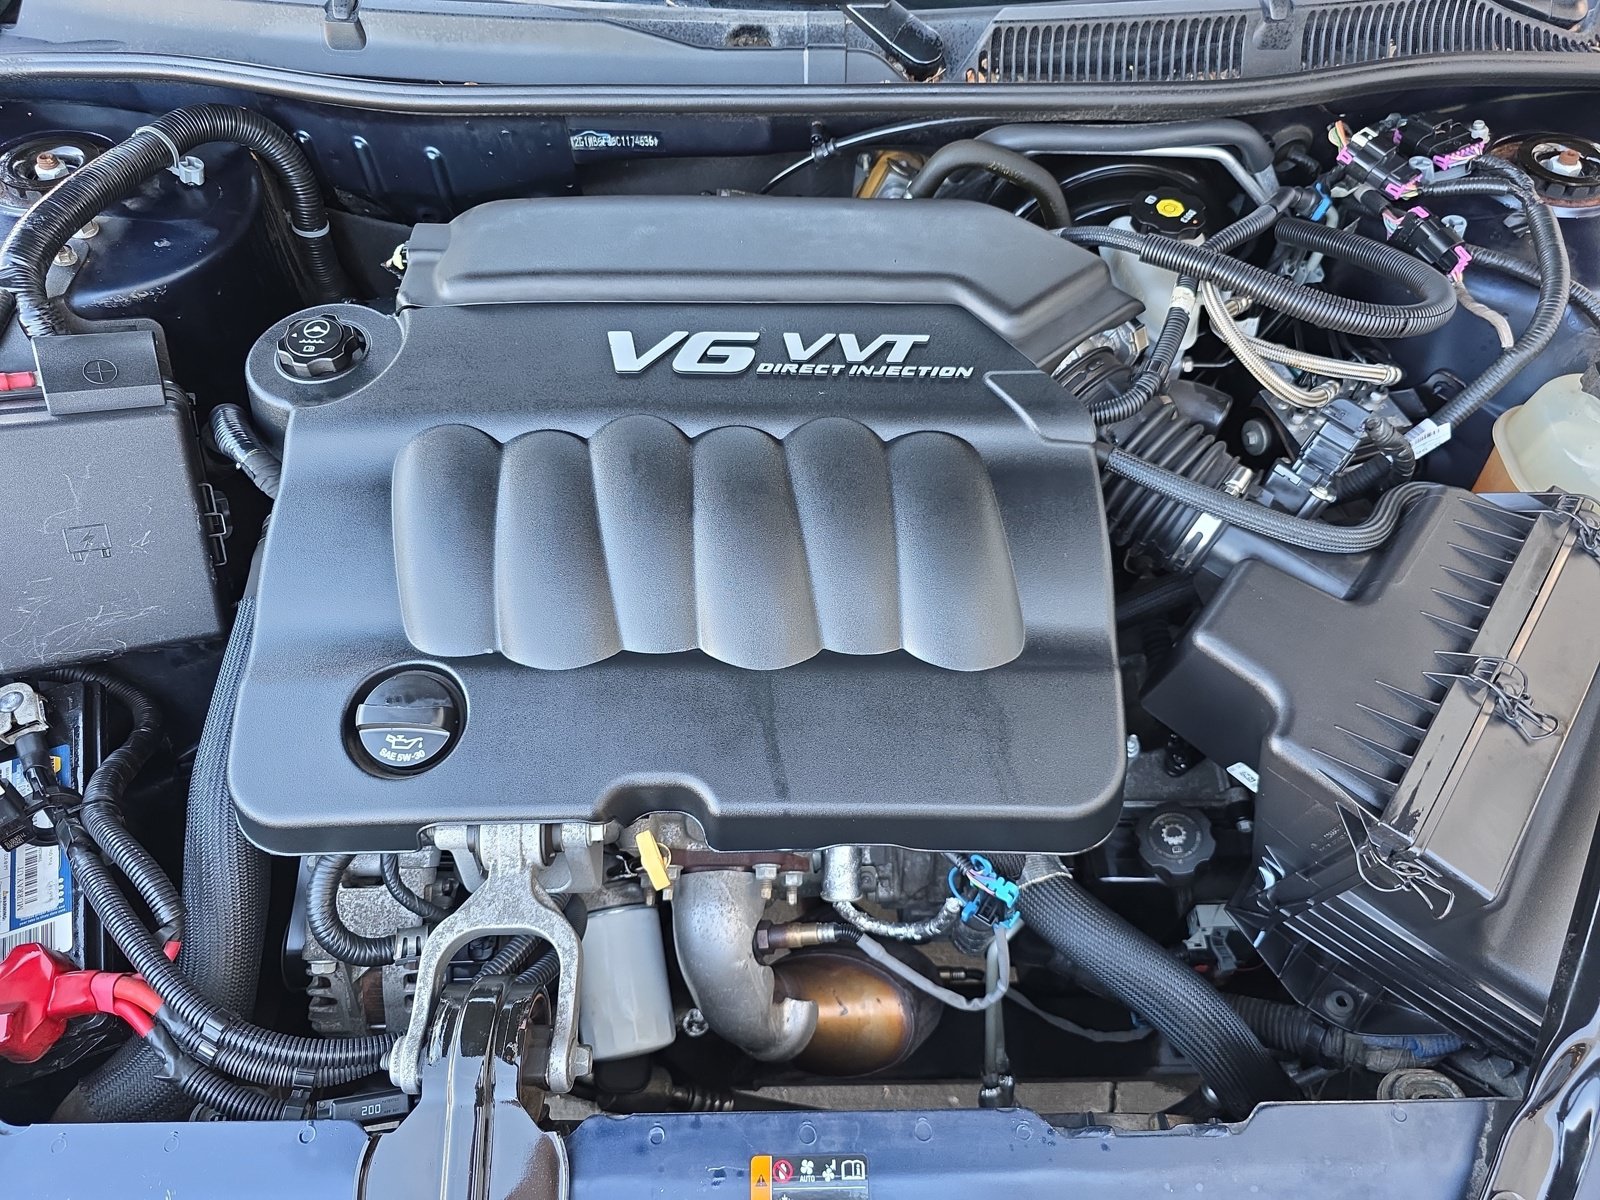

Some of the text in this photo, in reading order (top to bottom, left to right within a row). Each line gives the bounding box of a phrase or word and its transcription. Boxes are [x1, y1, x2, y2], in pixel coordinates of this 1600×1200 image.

[607, 330, 930, 375] V6 VVT
[756, 362, 974, 379] DIRECT INJECTION
[379, 747, 426, 762] SAE 5W-30
[361, 1103, 381, 1116] 200
[799, 1175, 816, 1183] AUTO
